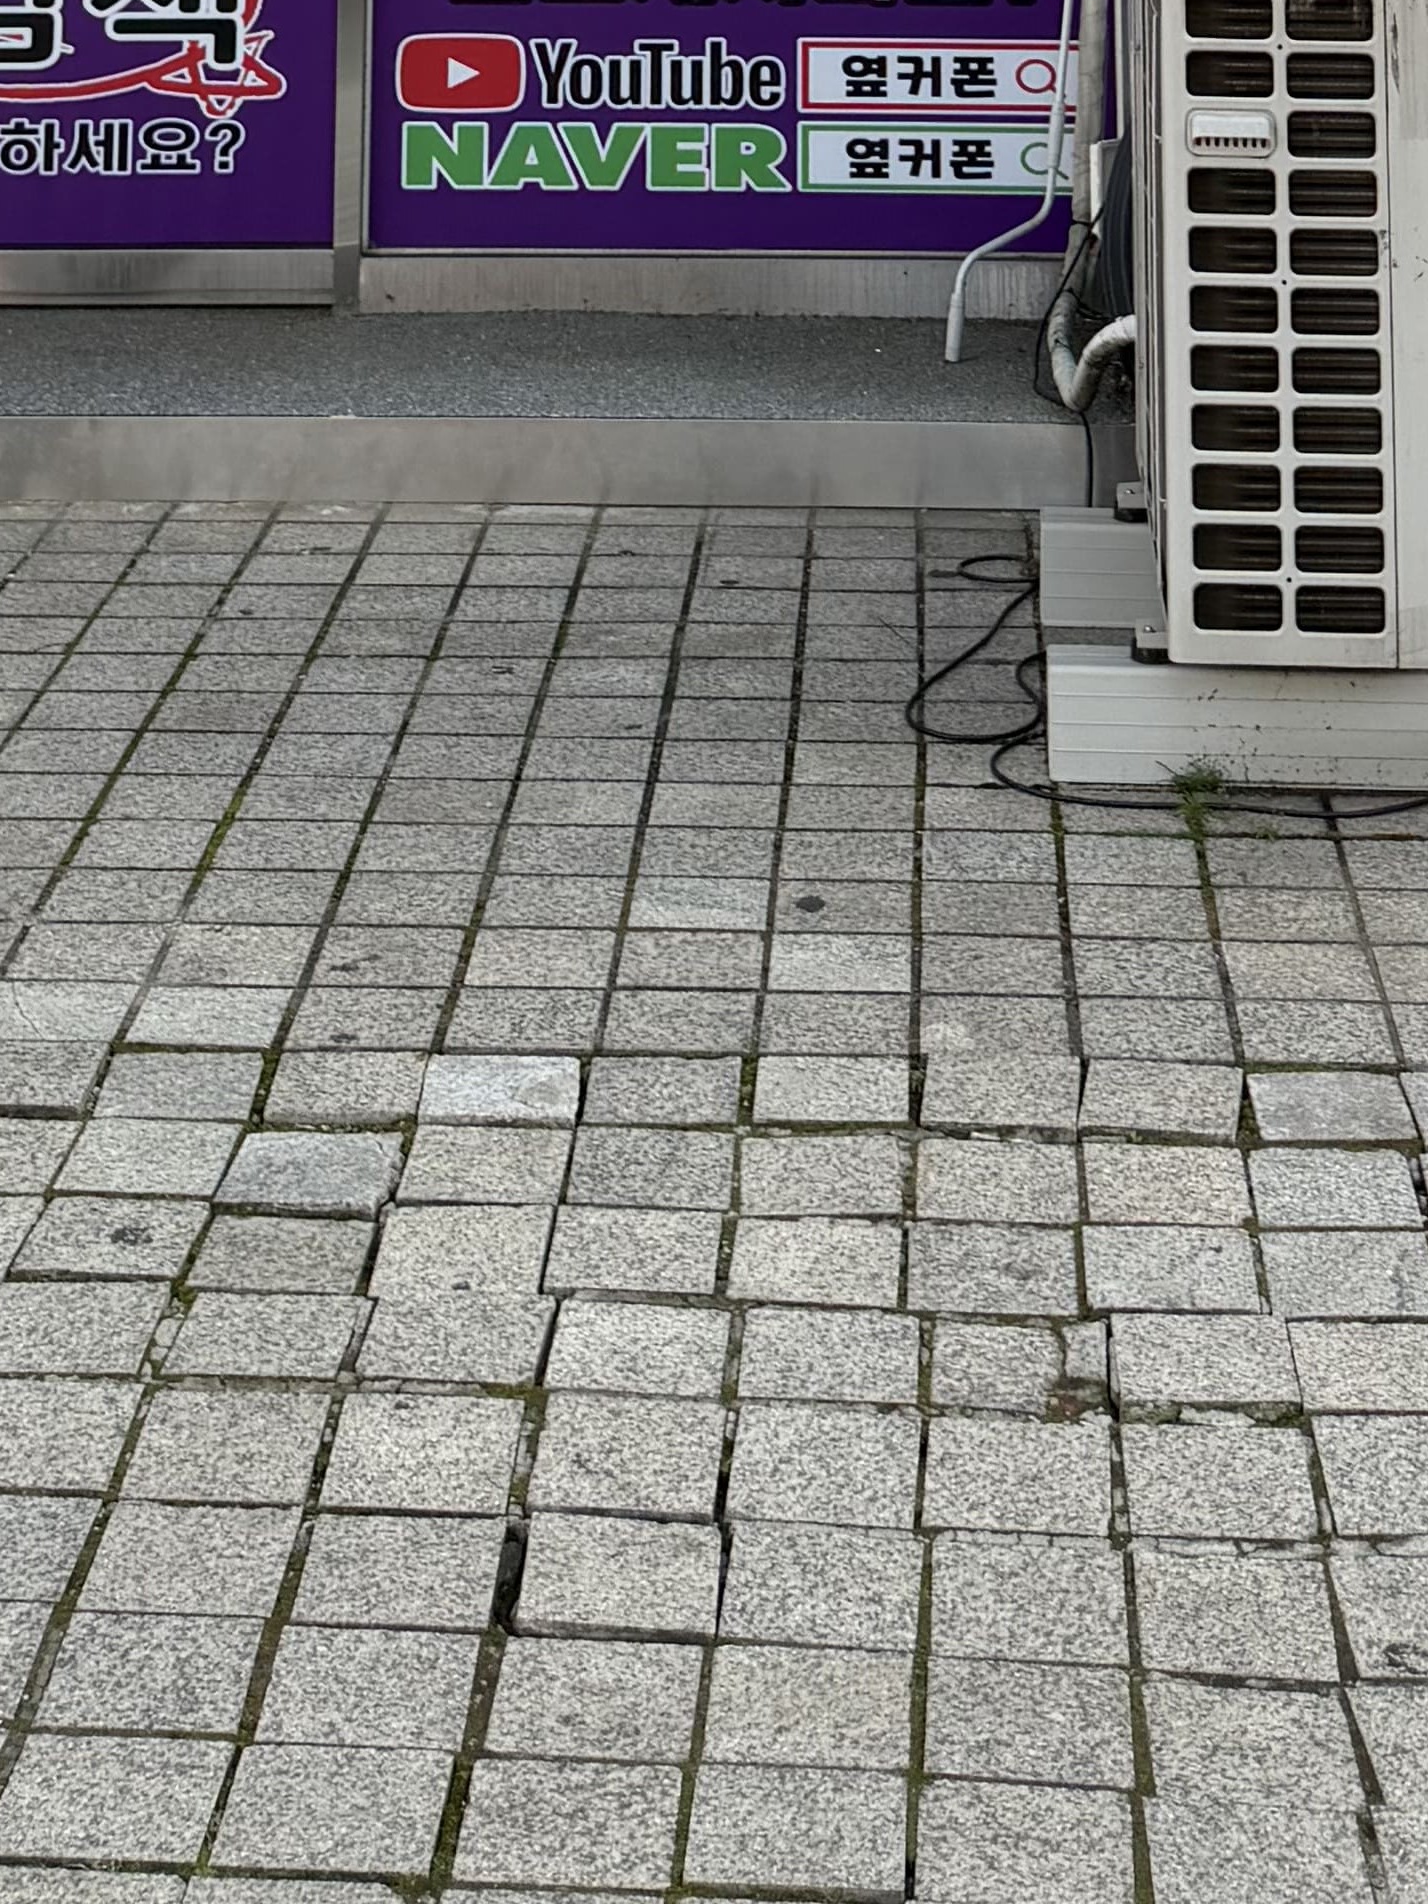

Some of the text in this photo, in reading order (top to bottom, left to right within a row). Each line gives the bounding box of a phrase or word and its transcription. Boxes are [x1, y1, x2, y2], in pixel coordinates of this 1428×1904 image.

[534, 41, 997, 108] YouTube 옆커폰
[403, 124, 995, 190] NAVER 옆커폰
